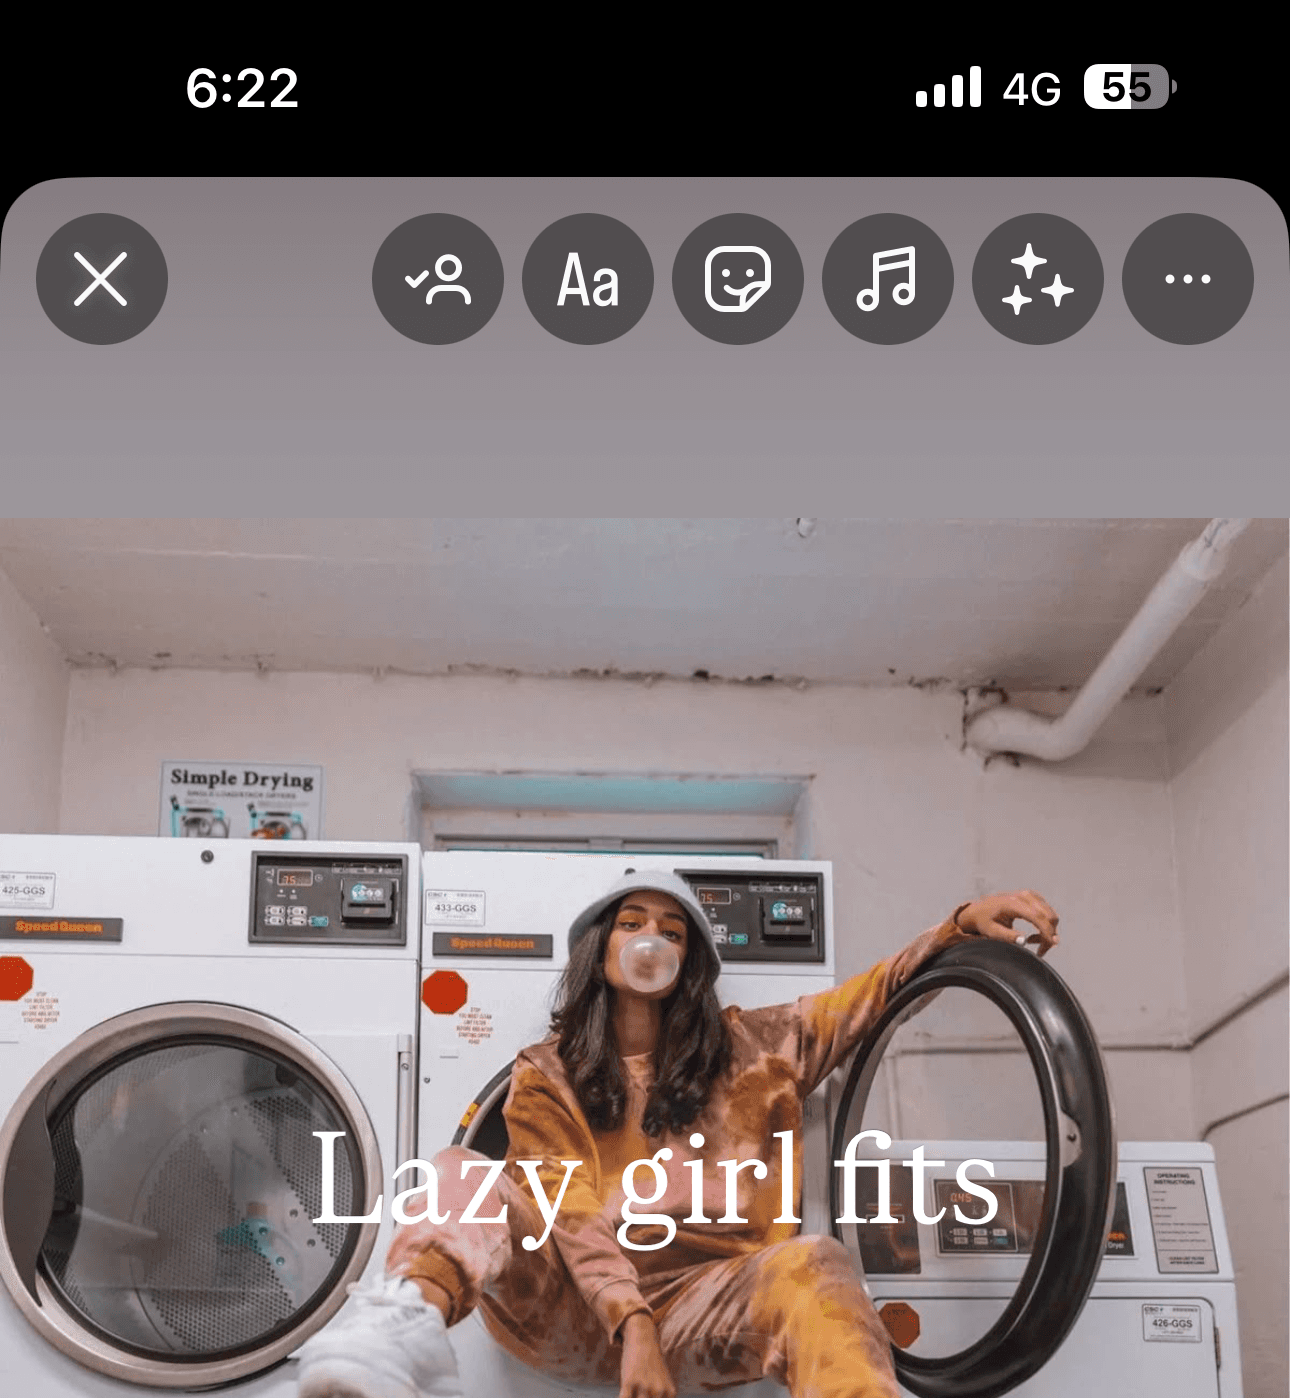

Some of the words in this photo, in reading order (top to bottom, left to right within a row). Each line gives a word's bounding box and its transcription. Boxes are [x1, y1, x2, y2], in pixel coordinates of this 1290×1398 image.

[170, 768, 237, 789] Simple
[243, 771, 314, 792] Drying
[2, 886, 46, 896] 425-GGS
[434, 904, 477, 913] 433-GGS
[1152, 1318, 1193, 1328] 426-GGS
